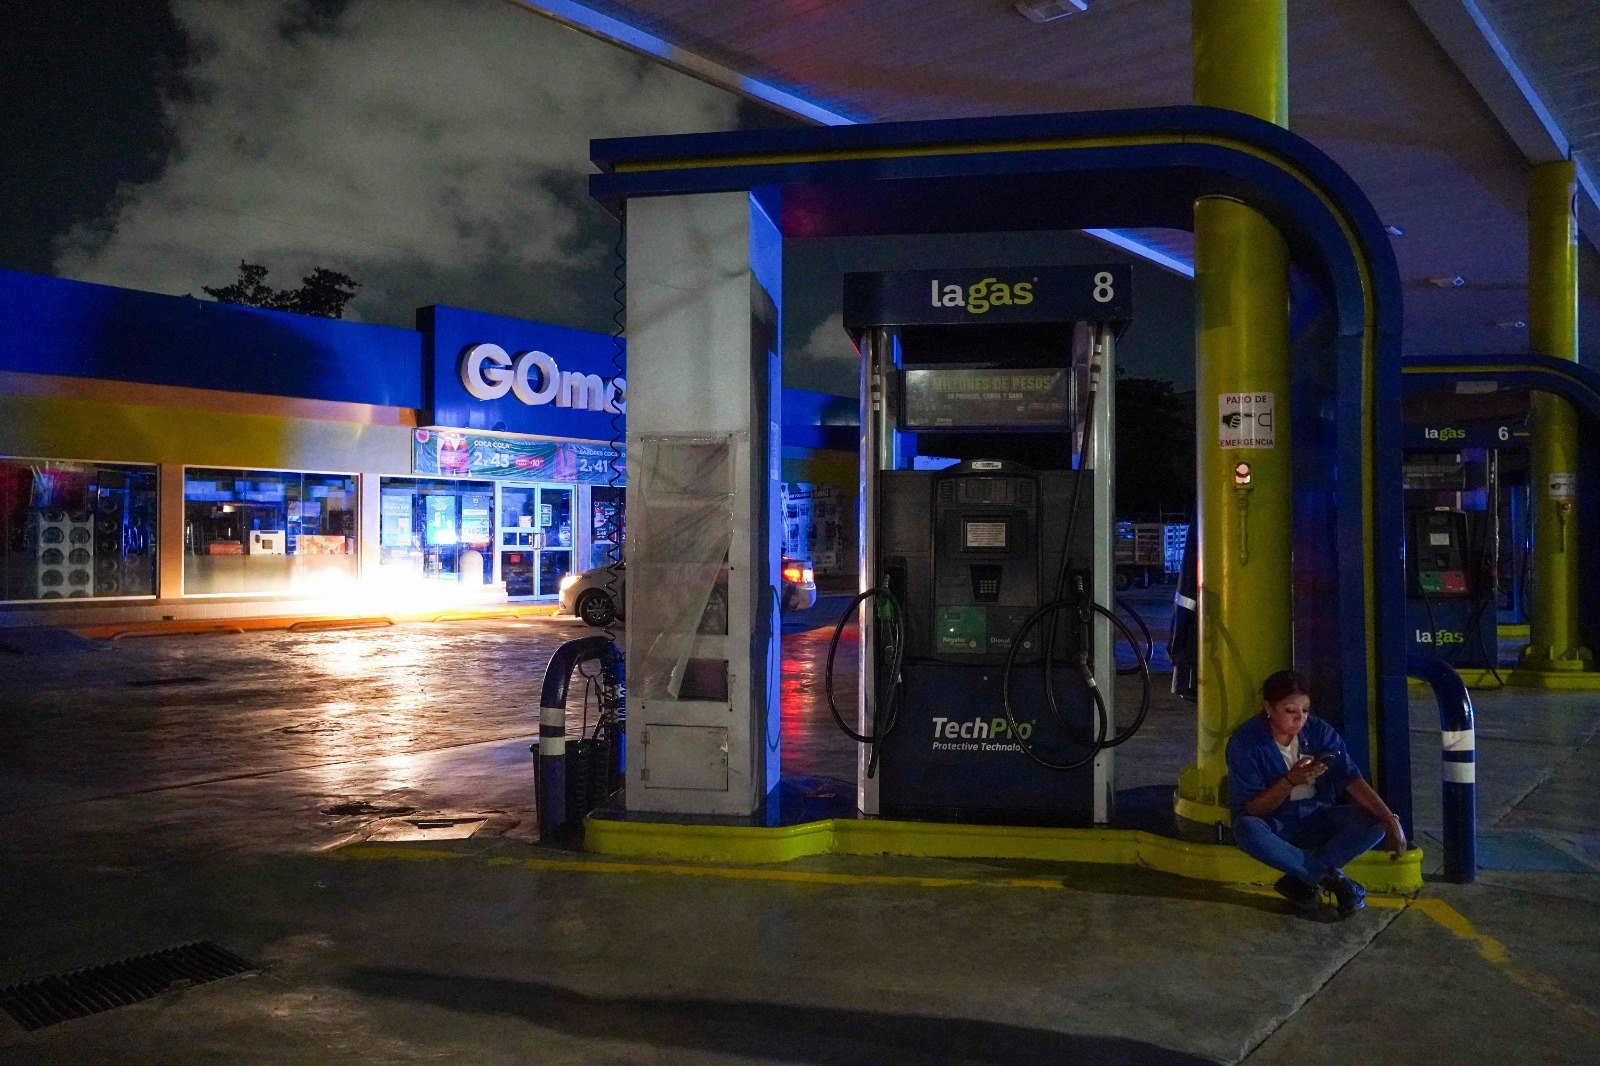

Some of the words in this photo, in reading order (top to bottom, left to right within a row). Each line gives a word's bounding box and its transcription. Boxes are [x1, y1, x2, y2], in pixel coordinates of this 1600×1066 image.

[931, 276, 1035, 314] lagas
[1092, 271, 1115, 303] 8
[1012, 375, 1052, 391] PESOS
[1255, 395, 1267, 404] DE
[1424, 426, 1467, 442] lagas
[1497, 426, 1509, 441] 6
[1220, 439, 1274, 448] EMERGENCIA
[932, 716, 1033, 740] TechPro
[932, 741, 979, 751] Protective
[980, 742, 1032, 754] Technolo
